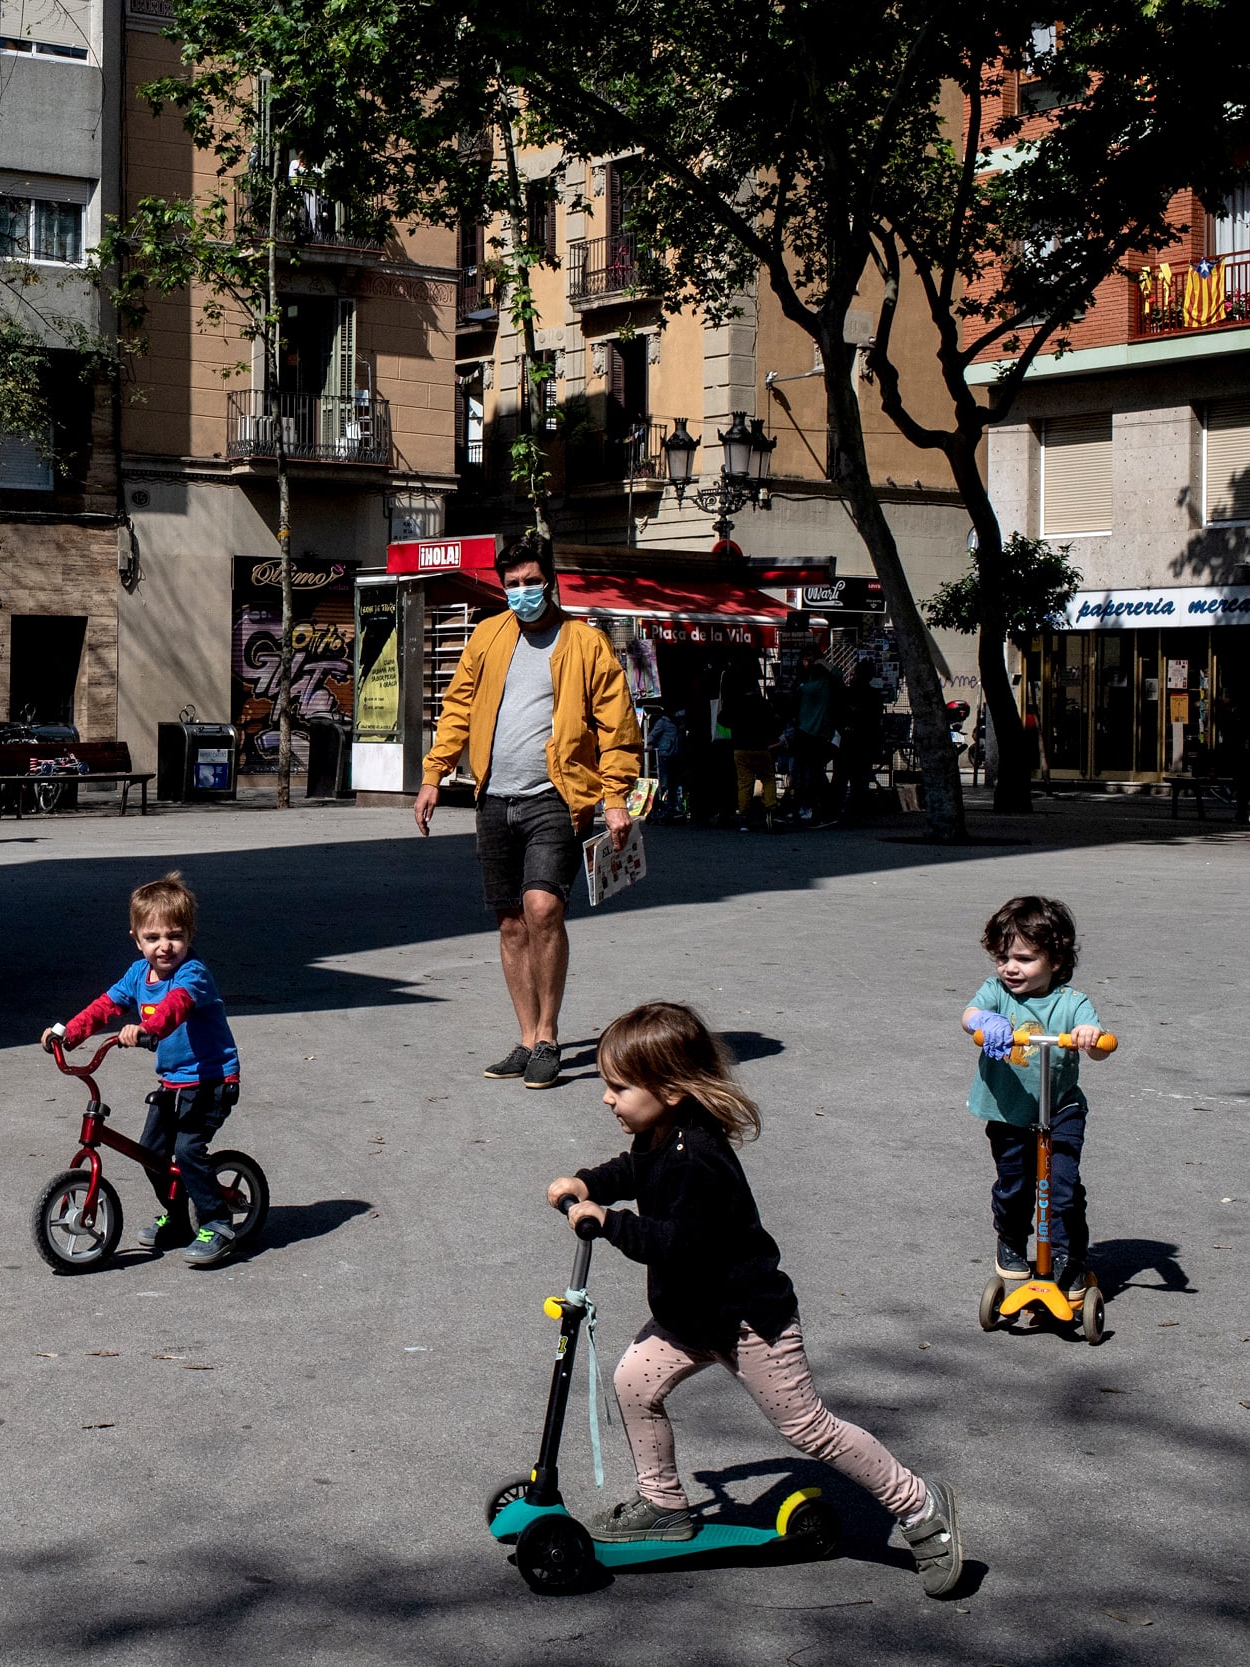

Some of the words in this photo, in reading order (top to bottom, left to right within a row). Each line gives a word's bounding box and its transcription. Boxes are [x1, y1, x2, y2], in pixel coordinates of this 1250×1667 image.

[420, 546, 459, 566] ¡HOLA!
[1075, 597, 1176, 623] papereria
[651, 624, 687, 644] Plaça
[691, 626, 707, 641] de
[710, 626, 723, 642] la
[727, 627, 751, 643] Vila
